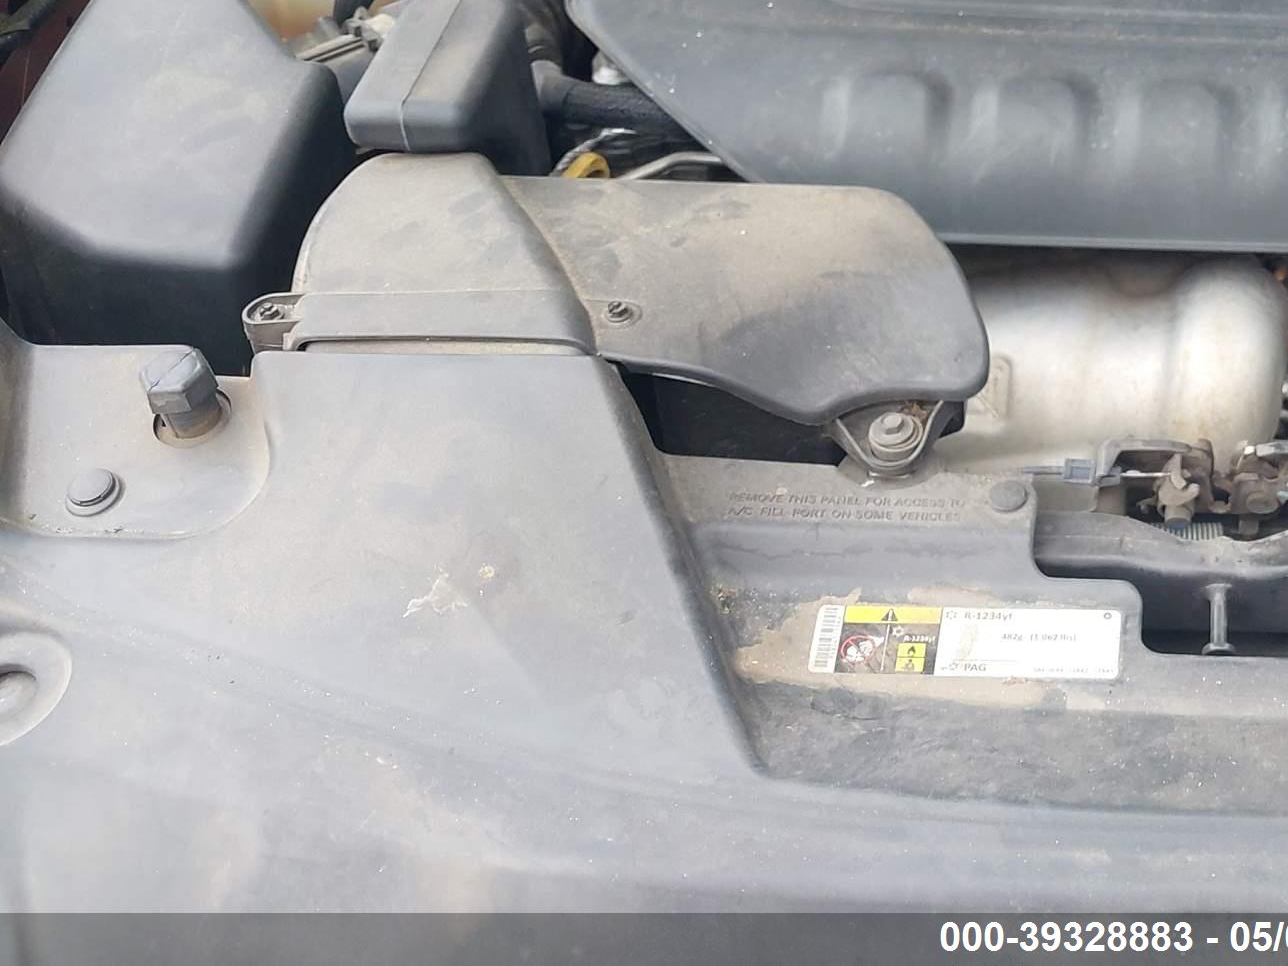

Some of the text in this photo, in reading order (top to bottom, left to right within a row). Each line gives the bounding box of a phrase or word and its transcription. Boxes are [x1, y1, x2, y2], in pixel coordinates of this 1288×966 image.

[788, 494, 817, 505] THIS
[820, 495, 861, 506] PANEL
[865, 497, 891, 507] FOR
[894, 497, 945, 508] ACCESS
[792, 507, 826, 518] PORT
[831, 509, 852, 519] ON
[855, 510, 894, 521] SOME
[900, 511, 961, 522] VEHICLES
[963, 662, 987, 672] PAG
